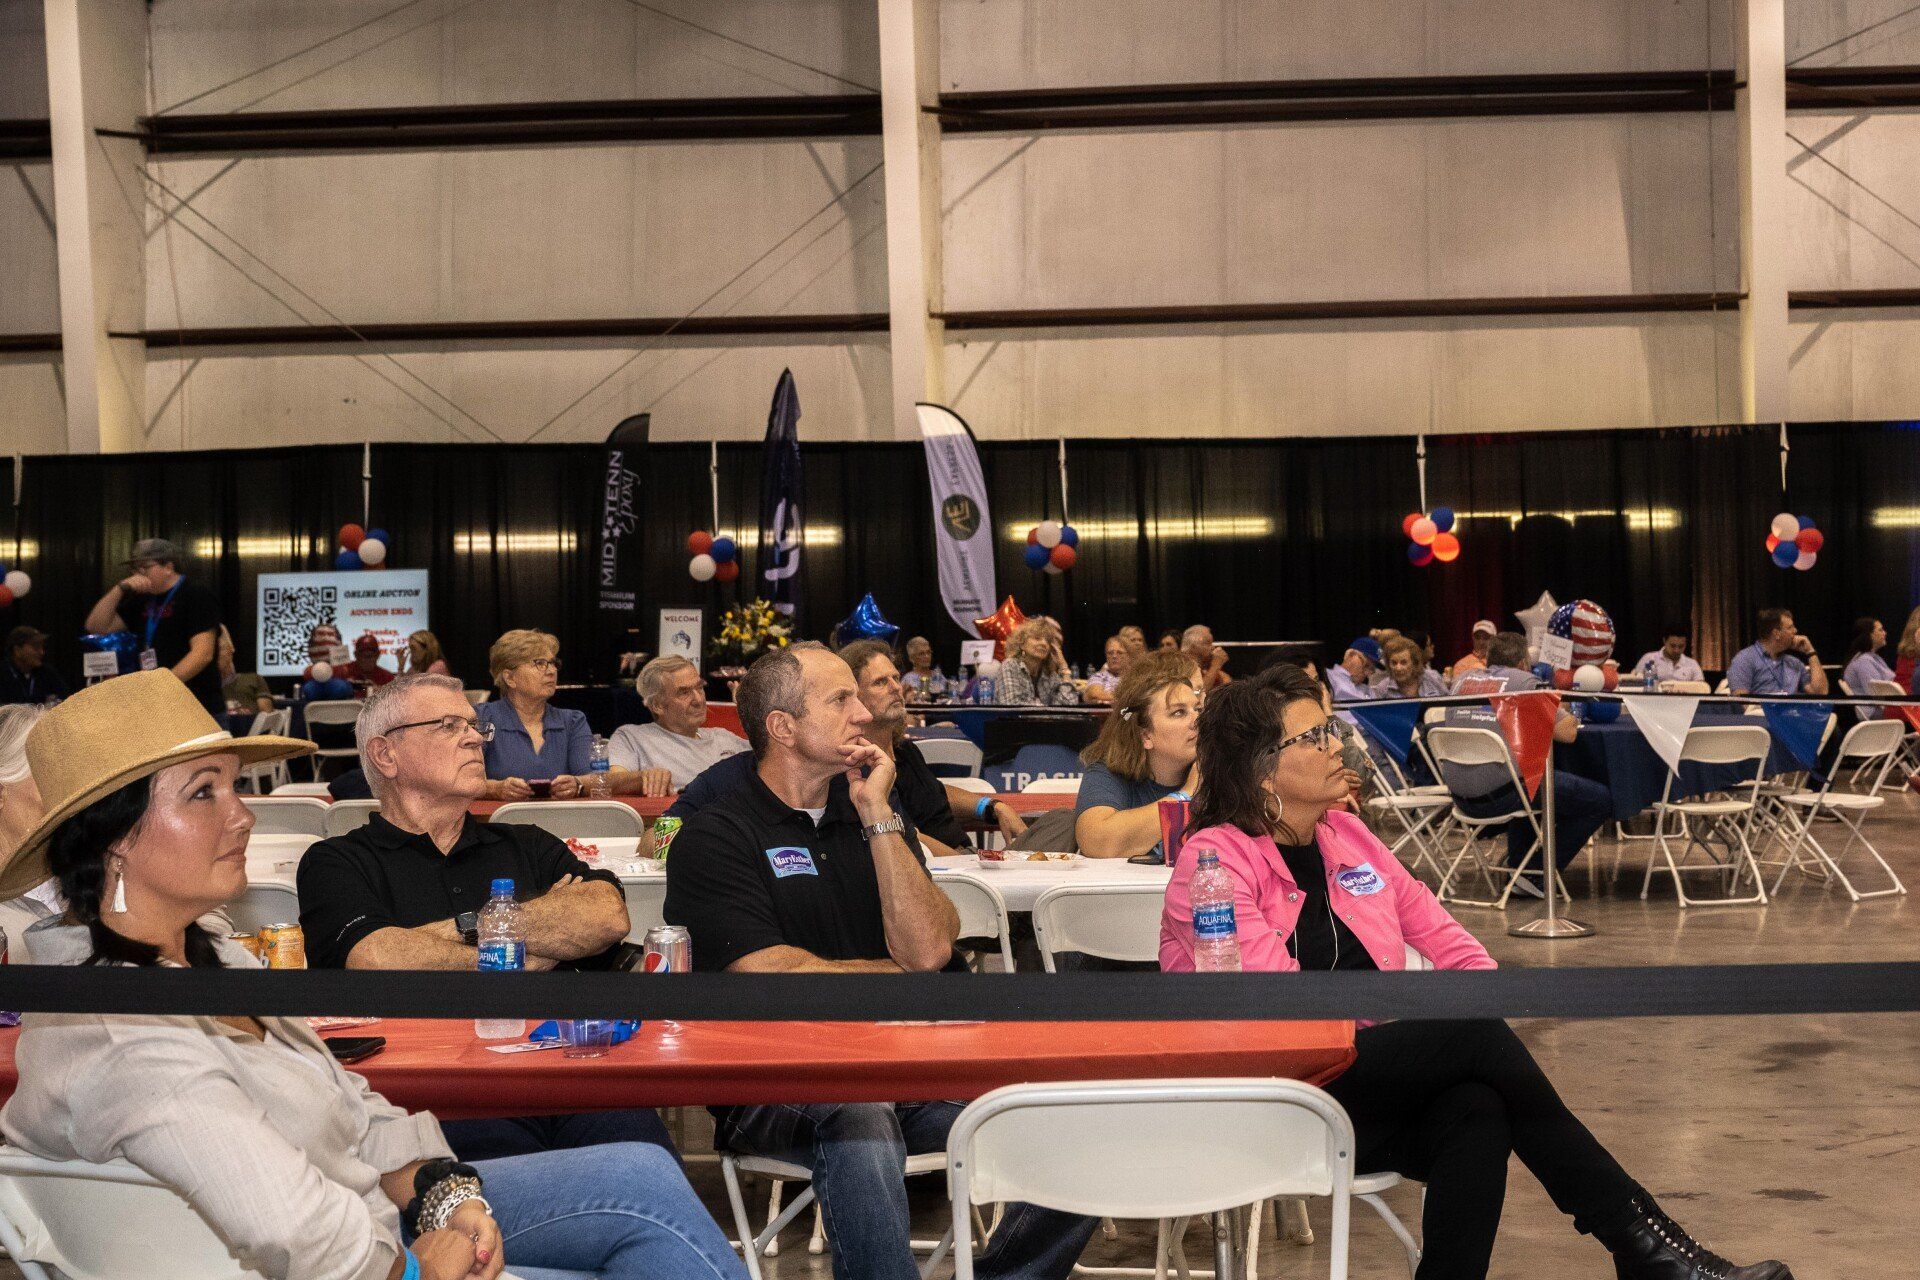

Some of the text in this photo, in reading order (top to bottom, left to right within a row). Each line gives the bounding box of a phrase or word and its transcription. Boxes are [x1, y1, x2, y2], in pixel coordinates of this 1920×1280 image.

[617, 468, 642, 534] Epoxy
[602, 451, 623, 586] MID TENN
[344, 588, 421, 599] ONLINE AUCTION
[350, 607, 414, 616] AUCTION ENDS
[664, 614, 700, 622] WELCOME
[1198, 912, 1235, 926] AQUAFINA
